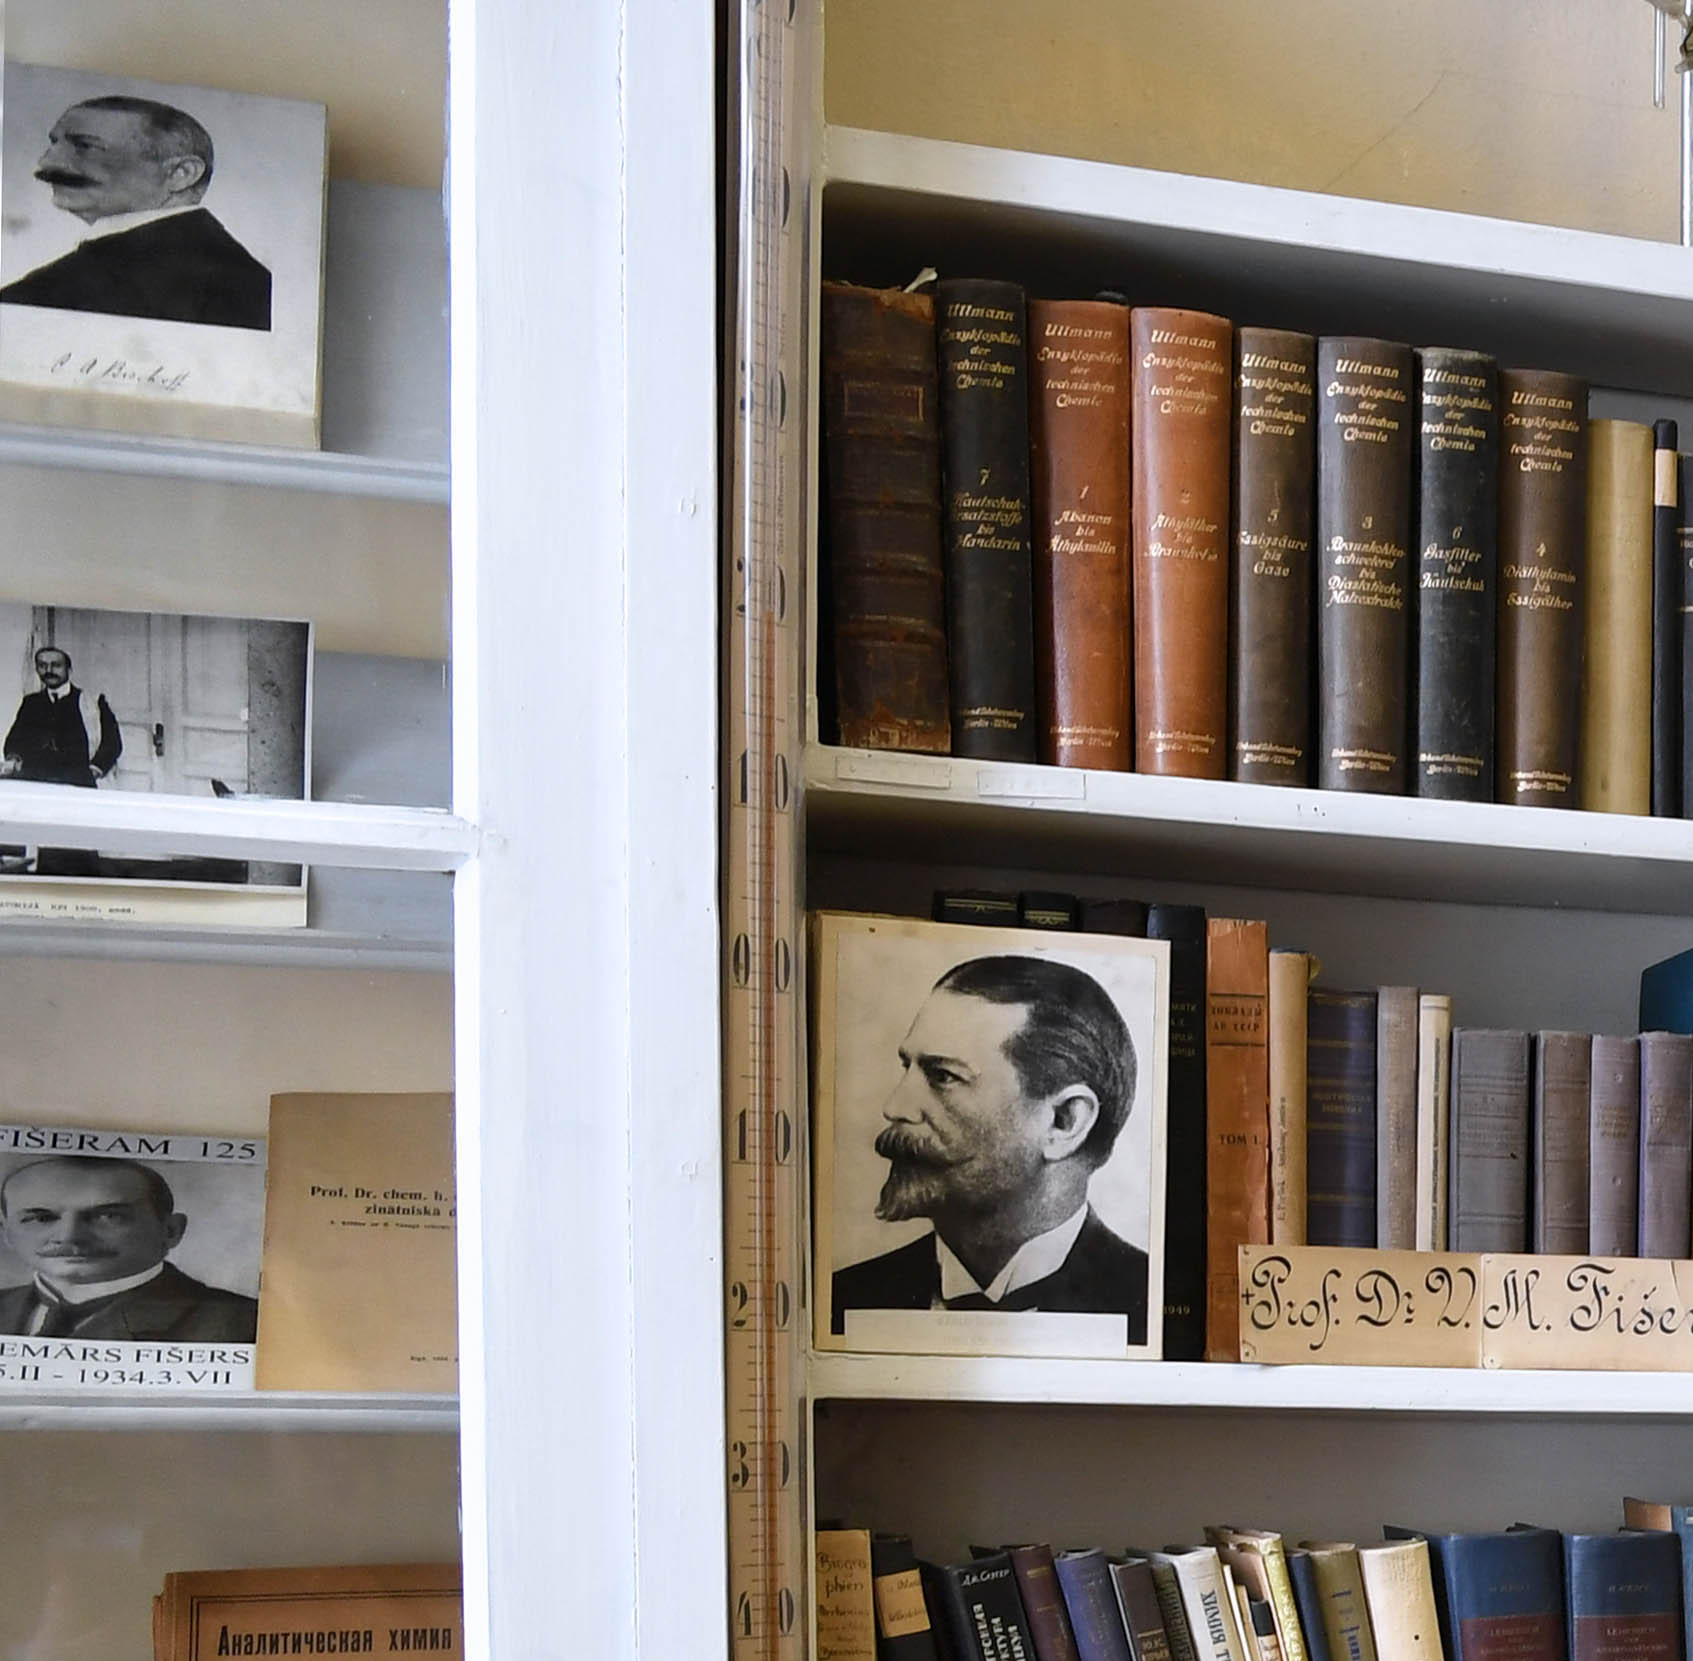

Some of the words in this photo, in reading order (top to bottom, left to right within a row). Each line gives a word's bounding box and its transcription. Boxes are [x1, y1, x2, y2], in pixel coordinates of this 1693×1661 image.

[1045, 323, 1112, 339] Ullmann
[1151, 330, 1217, 349] Ullmann
[1242, 353, 1306, 374] Ullmann
[1336, 359, 1399, 378] Ullmann
[1423, 368, 1486, 388] Ullmann
[1264, 393, 1285, 404] der
[1358, 401, 1377, 411] der
[1512, 391, 1573, 410] Ullmann
[200, 1141, 256, 1159] 125
[311, 1186, 348, 1198] Prof.
[354, 1187, 377, 1200] Dr.
[1250, 1255, 1341, 1351] Prof.
[1483, 1268, 1551, 1332] M.
[135, 1347, 250, 1366] FIŠERS
[1201, 1590, 1226, 1645] ХИМИЯ
[218, 1625, 373, 1656] Аналитическая
[389, 1629, 452, 1651] химия
